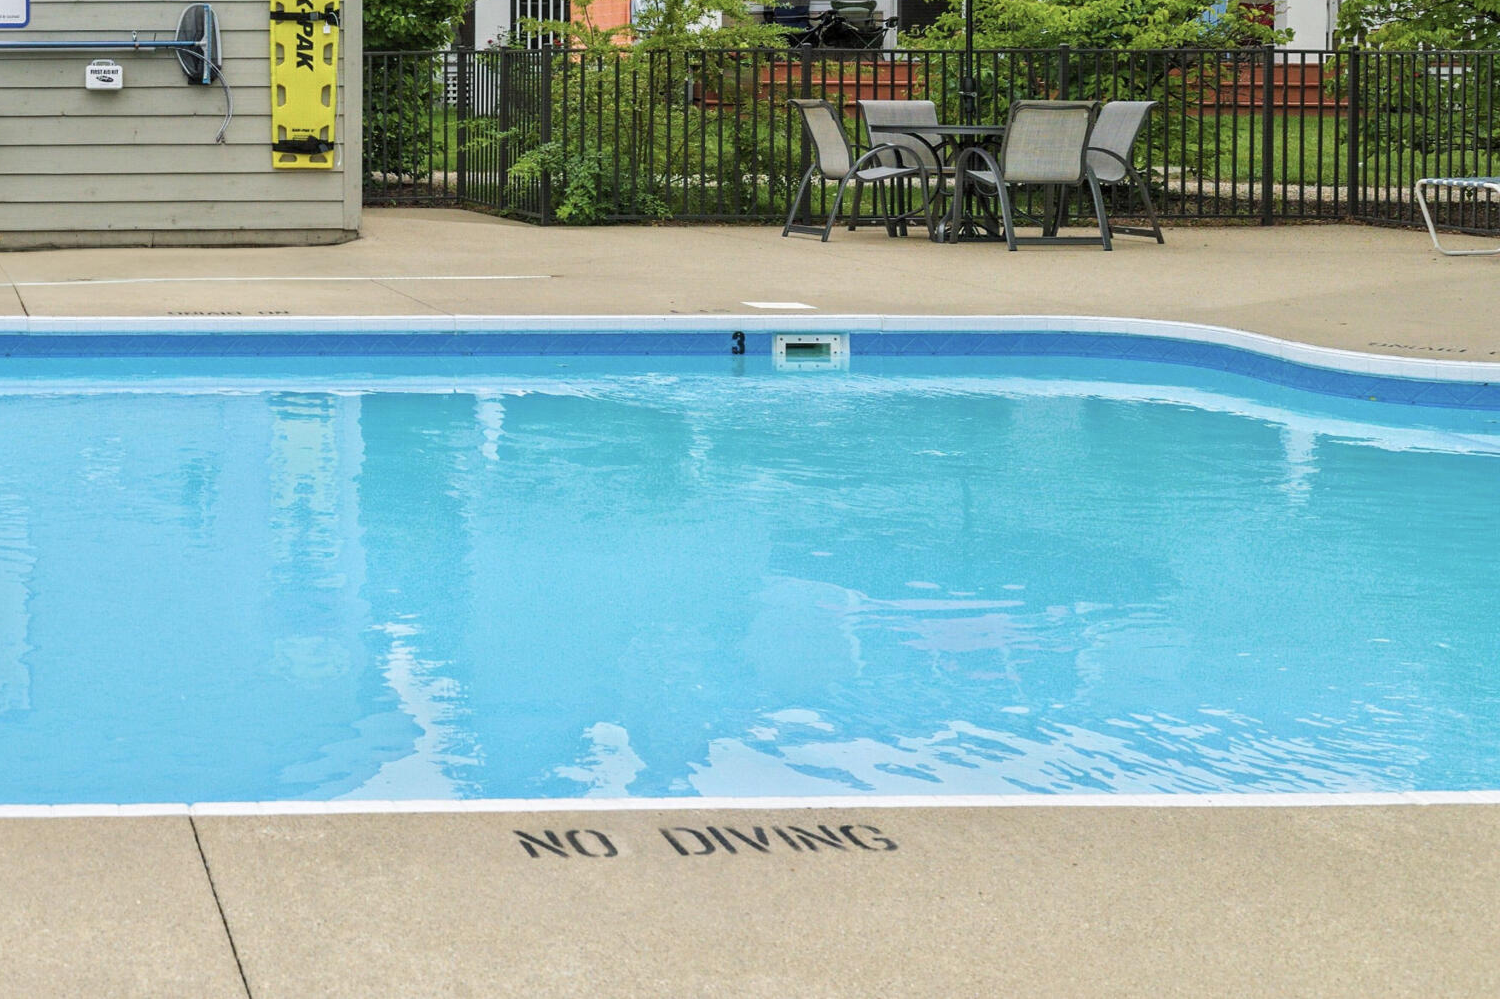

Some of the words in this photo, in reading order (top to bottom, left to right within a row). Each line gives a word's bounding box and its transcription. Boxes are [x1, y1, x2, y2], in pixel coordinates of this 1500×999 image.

[731, 331, 745, 355] 3
[512, 829, 619, 858] NO
[658, 824, 899, 854] DIVING
